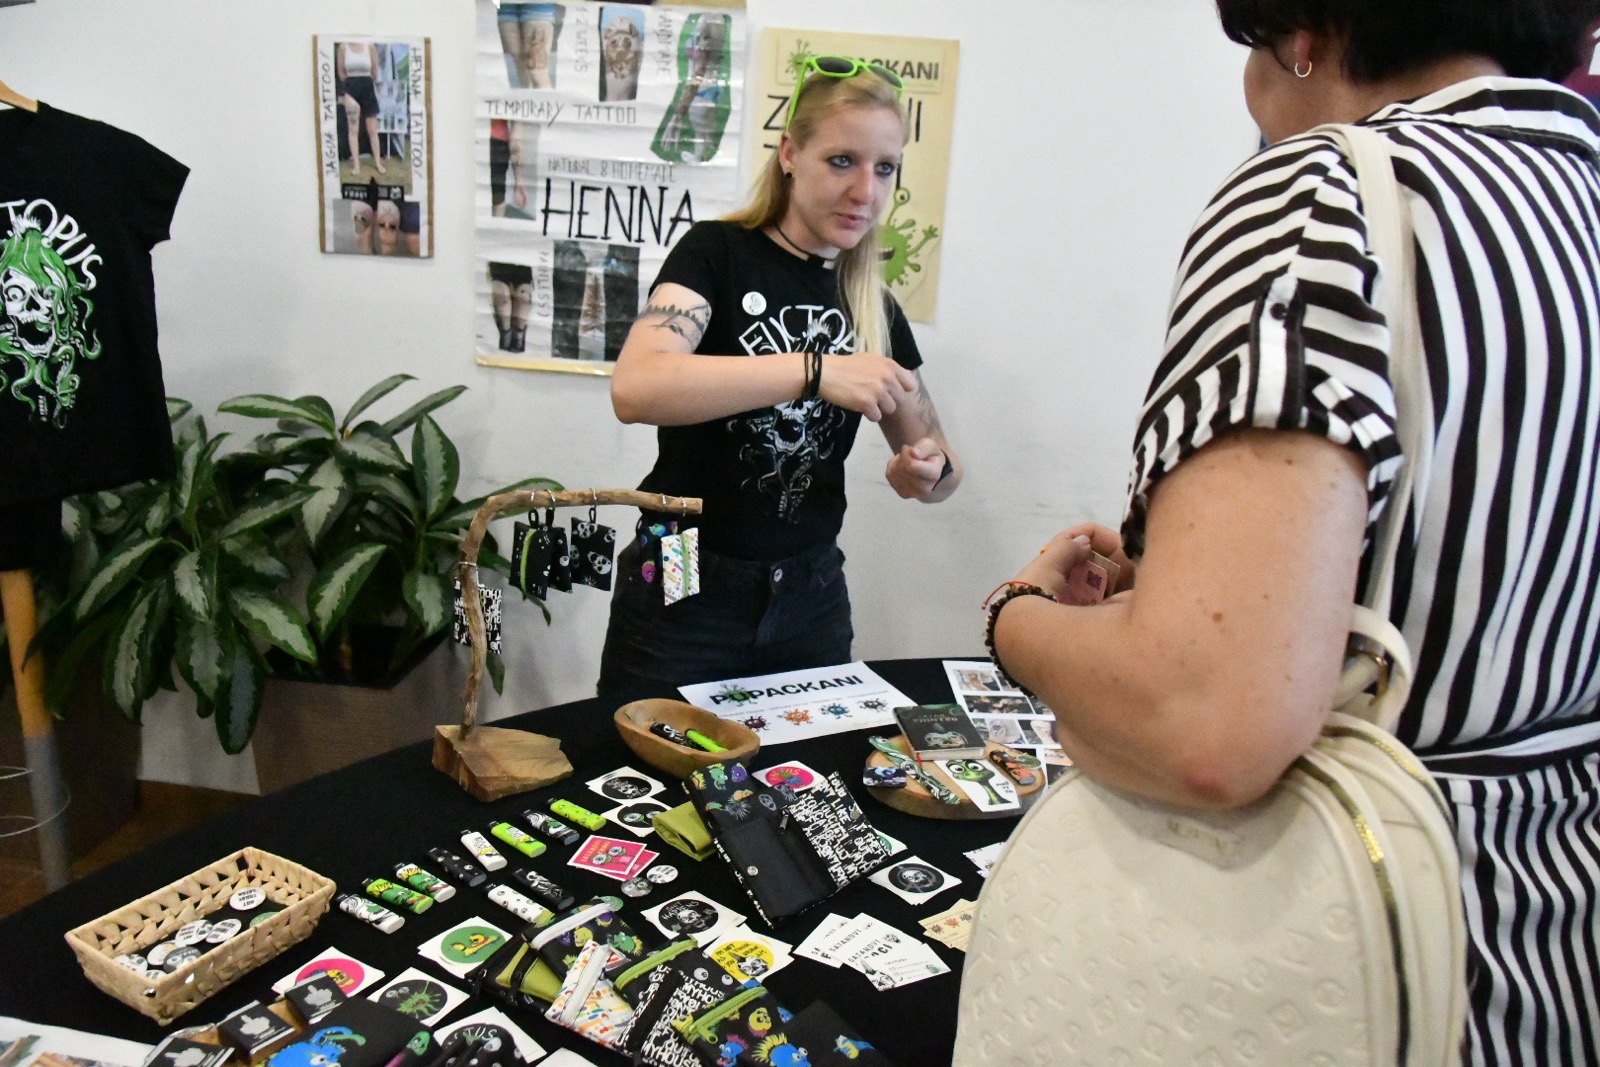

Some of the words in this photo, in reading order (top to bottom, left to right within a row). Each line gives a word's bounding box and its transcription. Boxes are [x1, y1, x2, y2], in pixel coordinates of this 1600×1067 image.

[484, 99, 565, 128] TEMPORARY
[573, 103, 637, 124] TATTOO
[541, 178, 696, 248] HENNA
